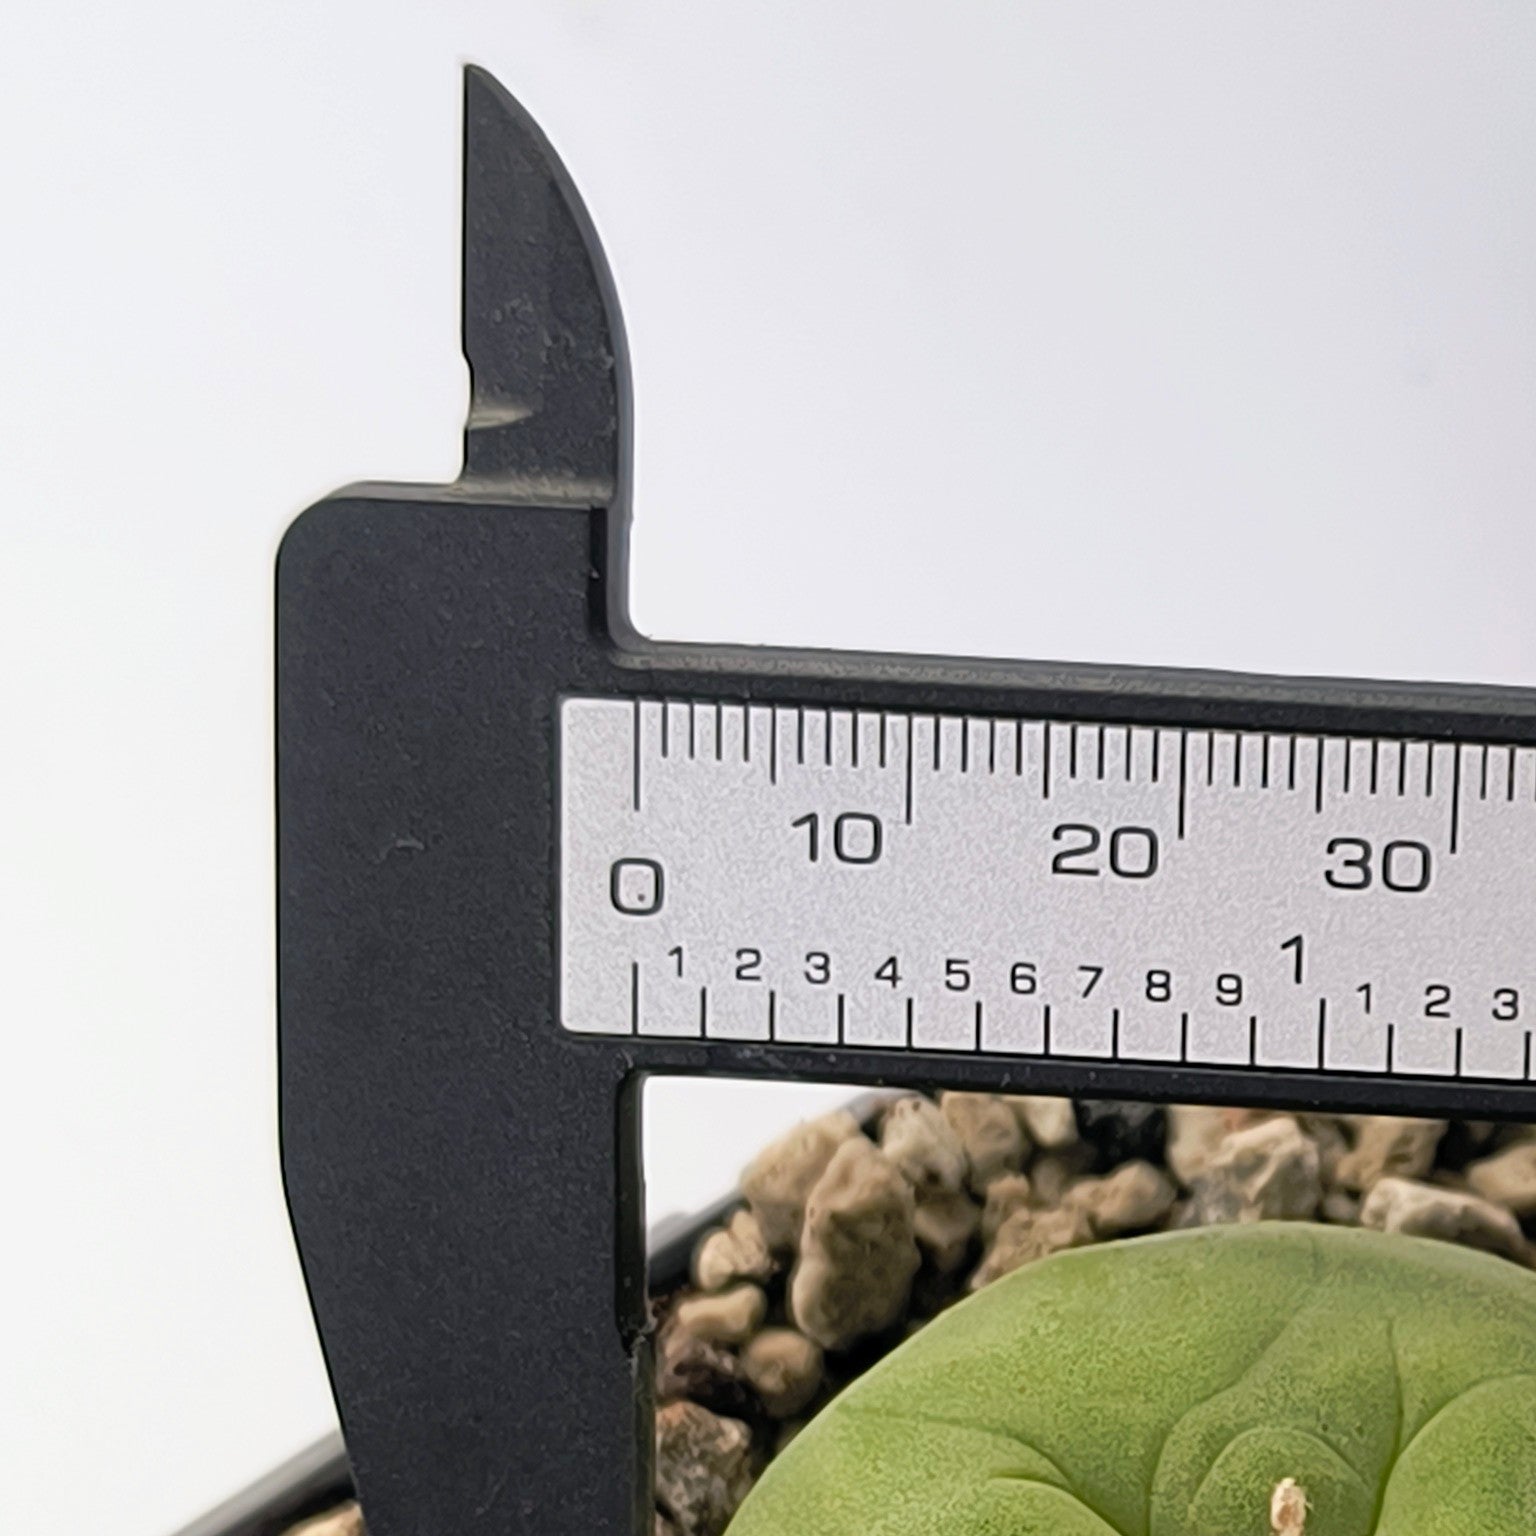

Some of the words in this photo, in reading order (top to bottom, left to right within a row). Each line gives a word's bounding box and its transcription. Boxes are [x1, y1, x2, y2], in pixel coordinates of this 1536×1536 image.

[610, 858, 664, 915] 0
[791, 812, 882, 864] 10
[1051, 823, 1159, 879] 20
[1324, 837, 1432, 893] 30
[668, 946, 683, 977] 1
[735, 948, 762, 981] 2
[804, 952, 831, 984] 3
[875, 956, 902, 988] 4
[945, 959, 972, 992] 5
[1010, 963, 1037, 995] 6
[1078, 966, 1103, 998] 7
[1146, 970, 1172, 1002] 8
[1217, 974, 1243, 1005] 9
[1281, 935, 1303, 984] 1
[1356, 983, 1372, 1014] 1
[1425, 985, 1451, 1018] 2
[1492, 988, 1519, 1022] 3
